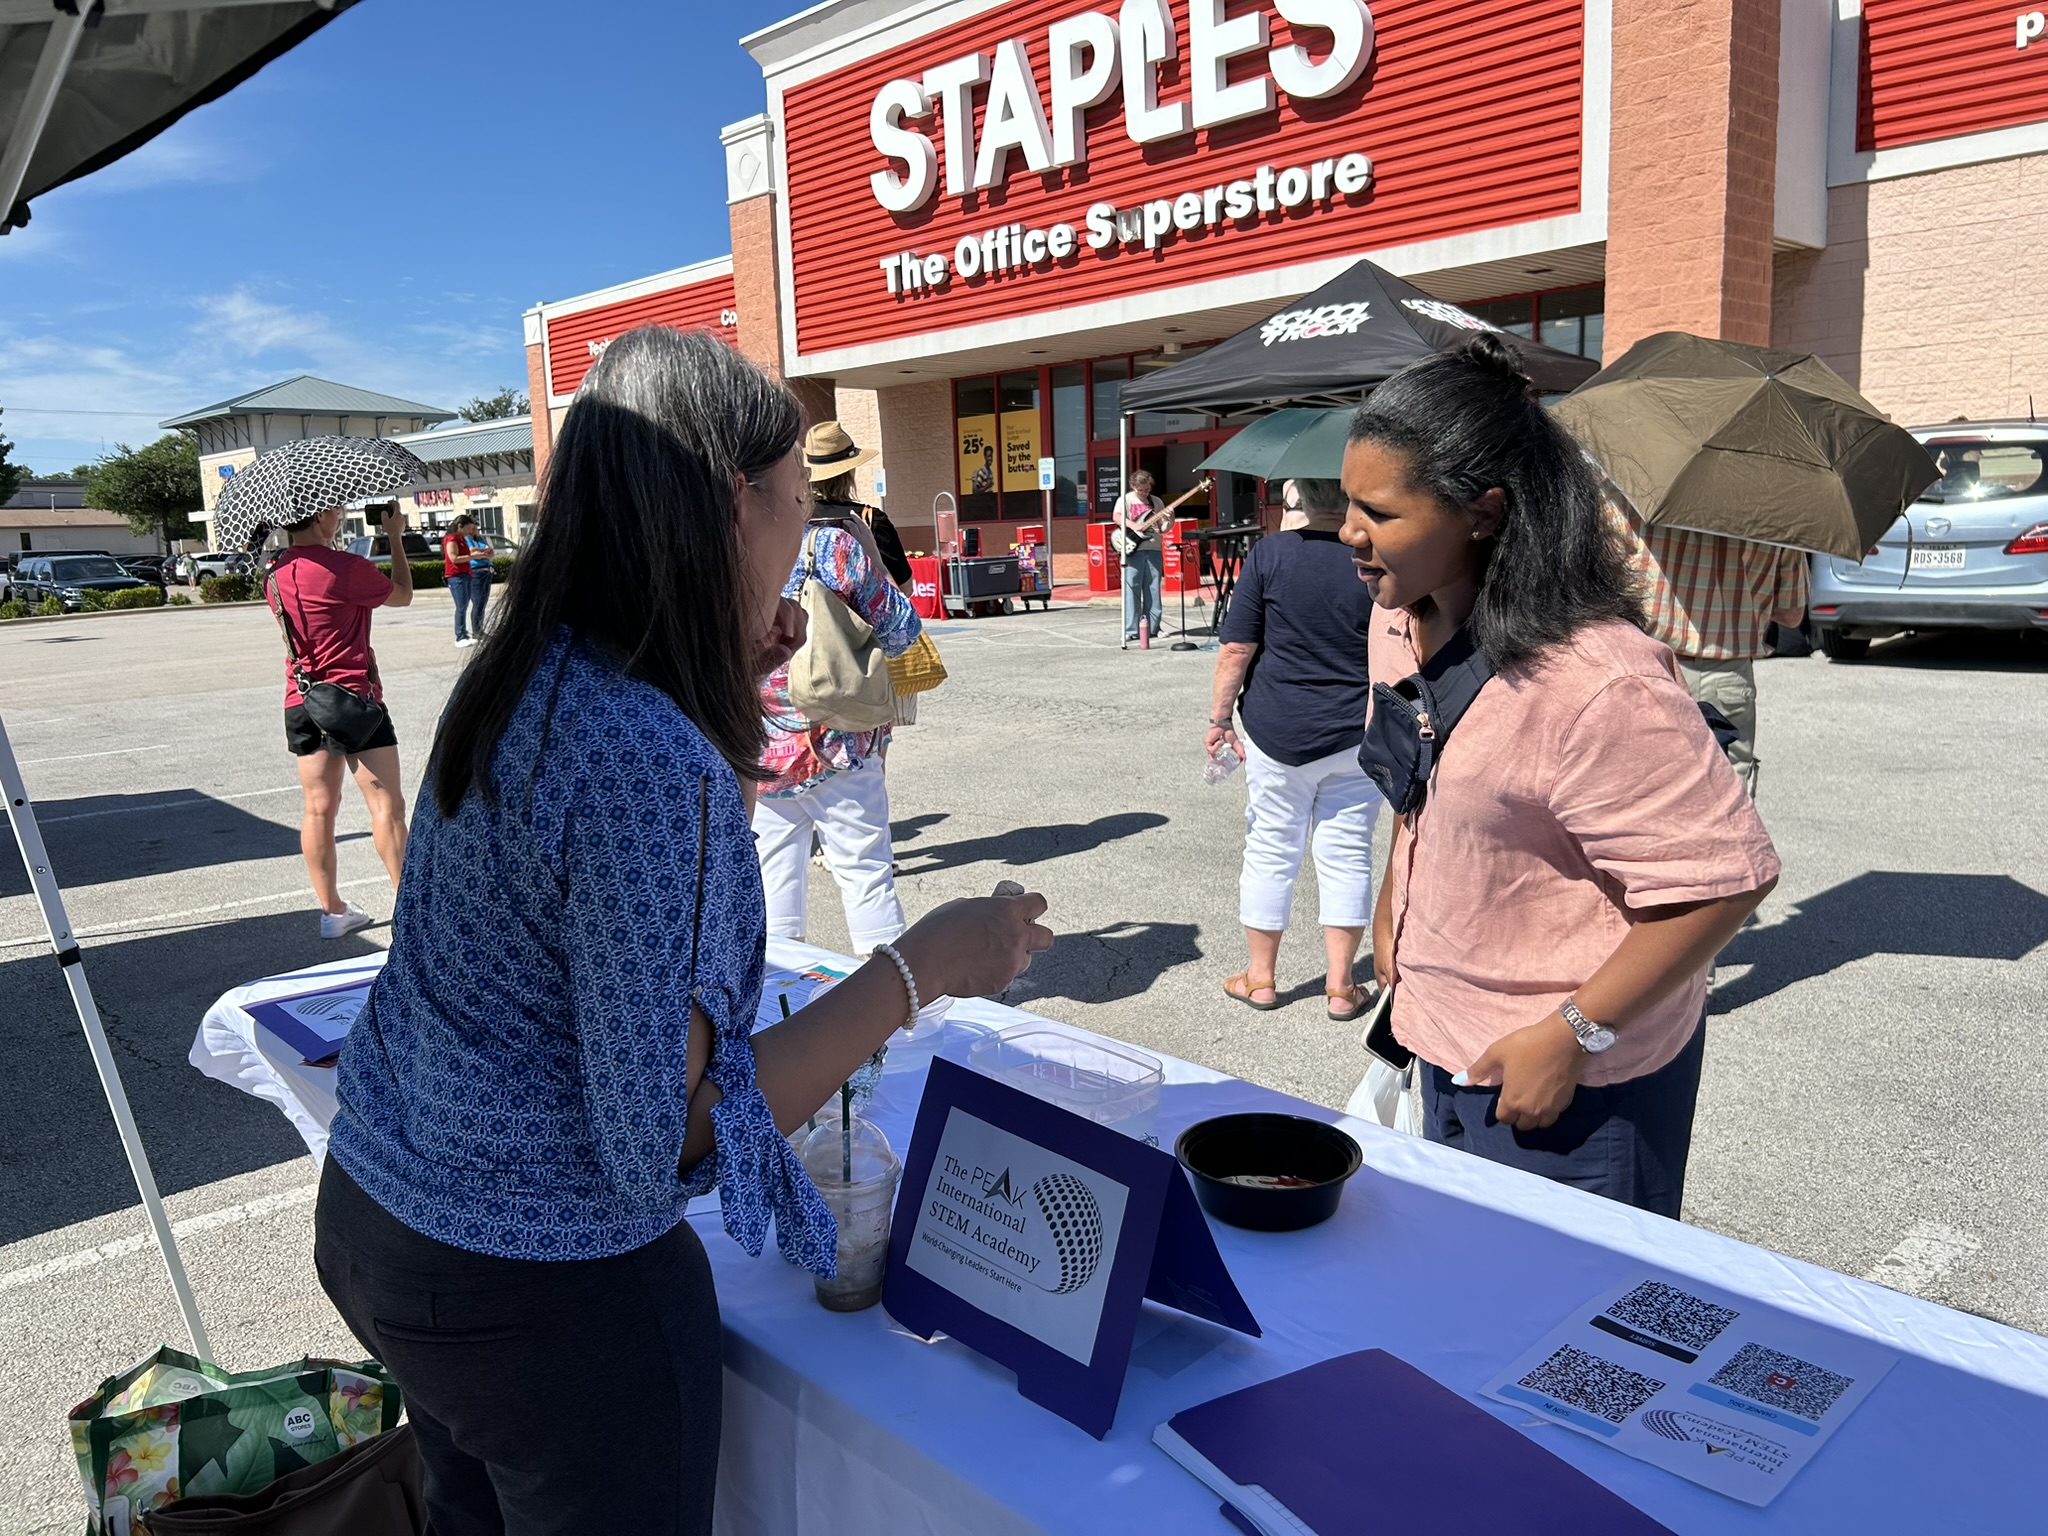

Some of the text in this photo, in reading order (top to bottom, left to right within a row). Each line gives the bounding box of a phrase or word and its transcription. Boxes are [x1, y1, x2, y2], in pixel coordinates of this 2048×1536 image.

[870, 0, 1374, 212] STAPLES
[880, 152, 1373, 294] The Office Superstore
[963, 438, 984, 455] 25¢
[1007, 441, 1030, 452] Saved
[1008, 452, 1031, 464] by the
[944, 1155, 1027, 1210] The PEAK
[936, 1176, 1027, 1234] International
[929, 1200, 1041, 1273] STEM Academy
[922, 1232, 1022, 1293] World-Changing Leaders Start Here
[288, 1414, 310, 1426] ABC
[1553, 1406, 1571, 1417] SIGN
[1679, 1414, 1791, 1459] STEM Academy
[1689, 1427, 1784, 1468] International
[1694, 1436, 1776, 1475] The PEAK
